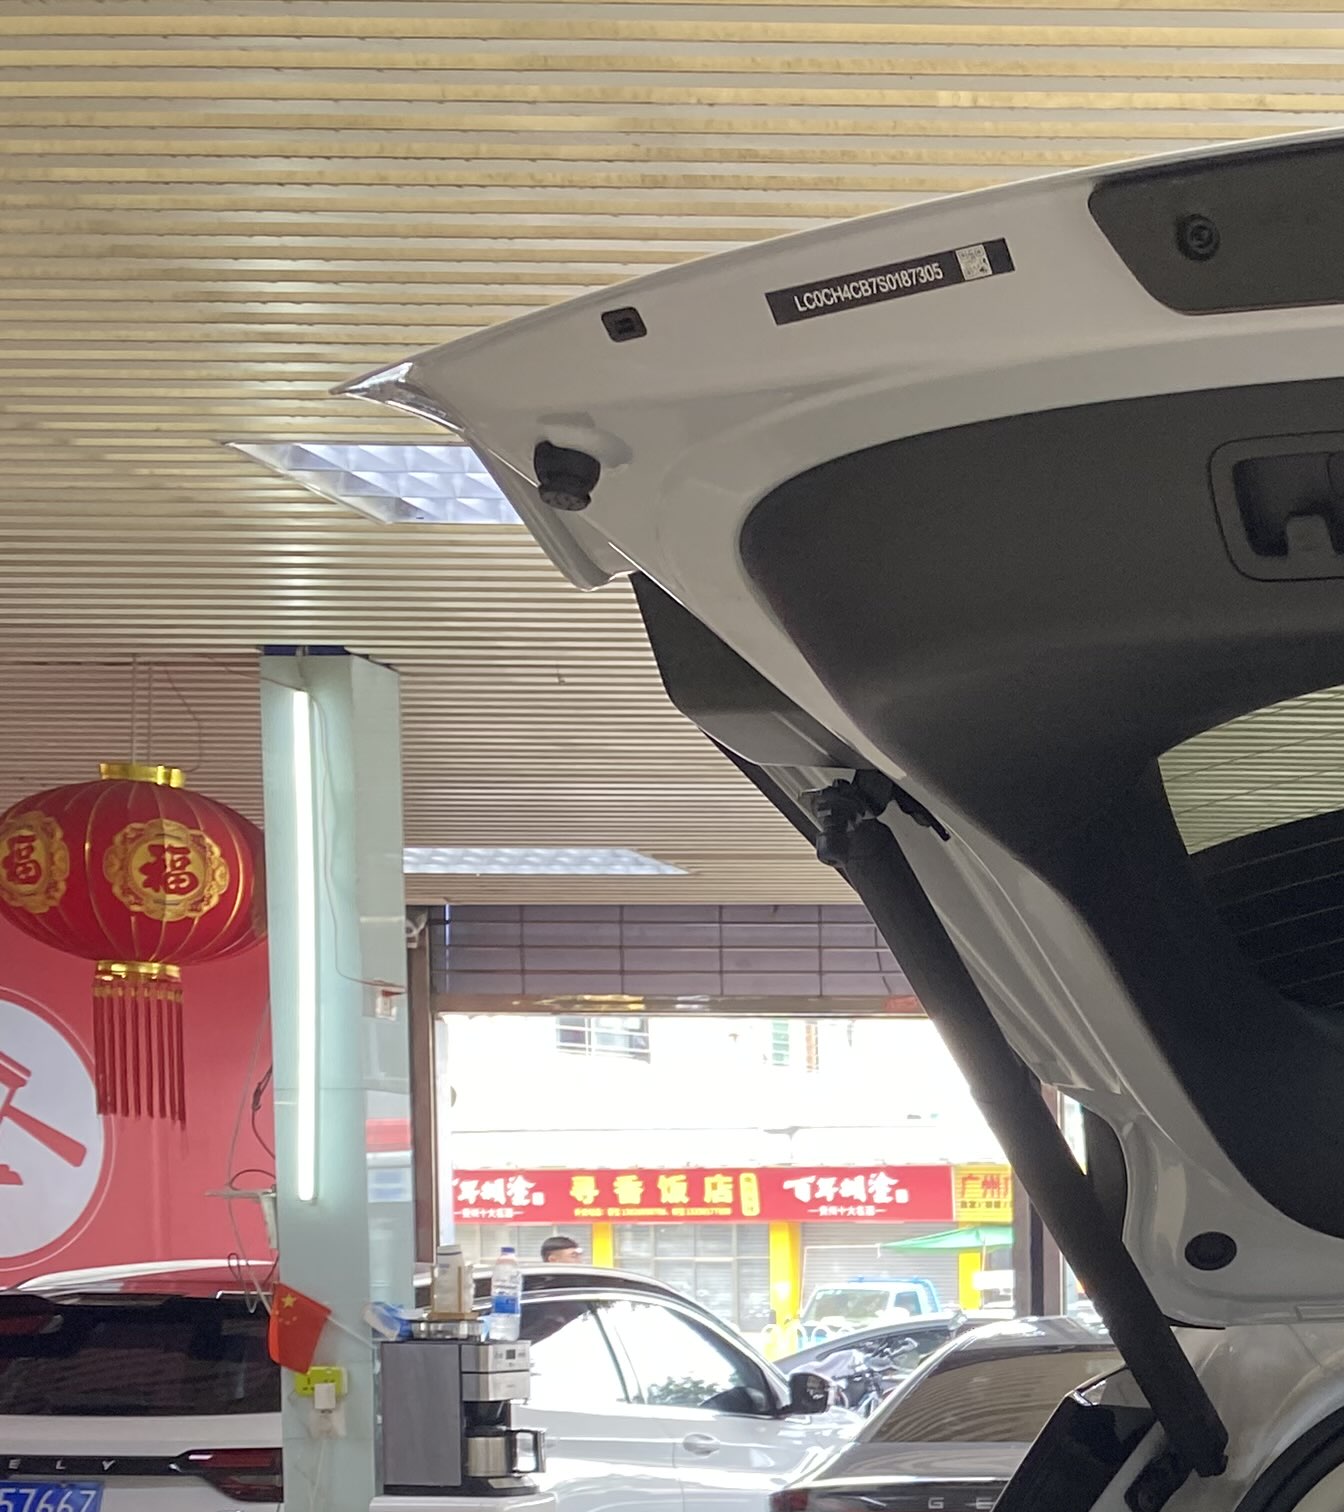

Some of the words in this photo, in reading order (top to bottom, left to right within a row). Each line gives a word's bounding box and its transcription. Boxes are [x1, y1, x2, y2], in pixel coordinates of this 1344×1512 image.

[794, 262, 943, 311] LC0CH4CB7S0187305
[2, 834, 42, 884] 福
[138, 844, 200, 895] 福
